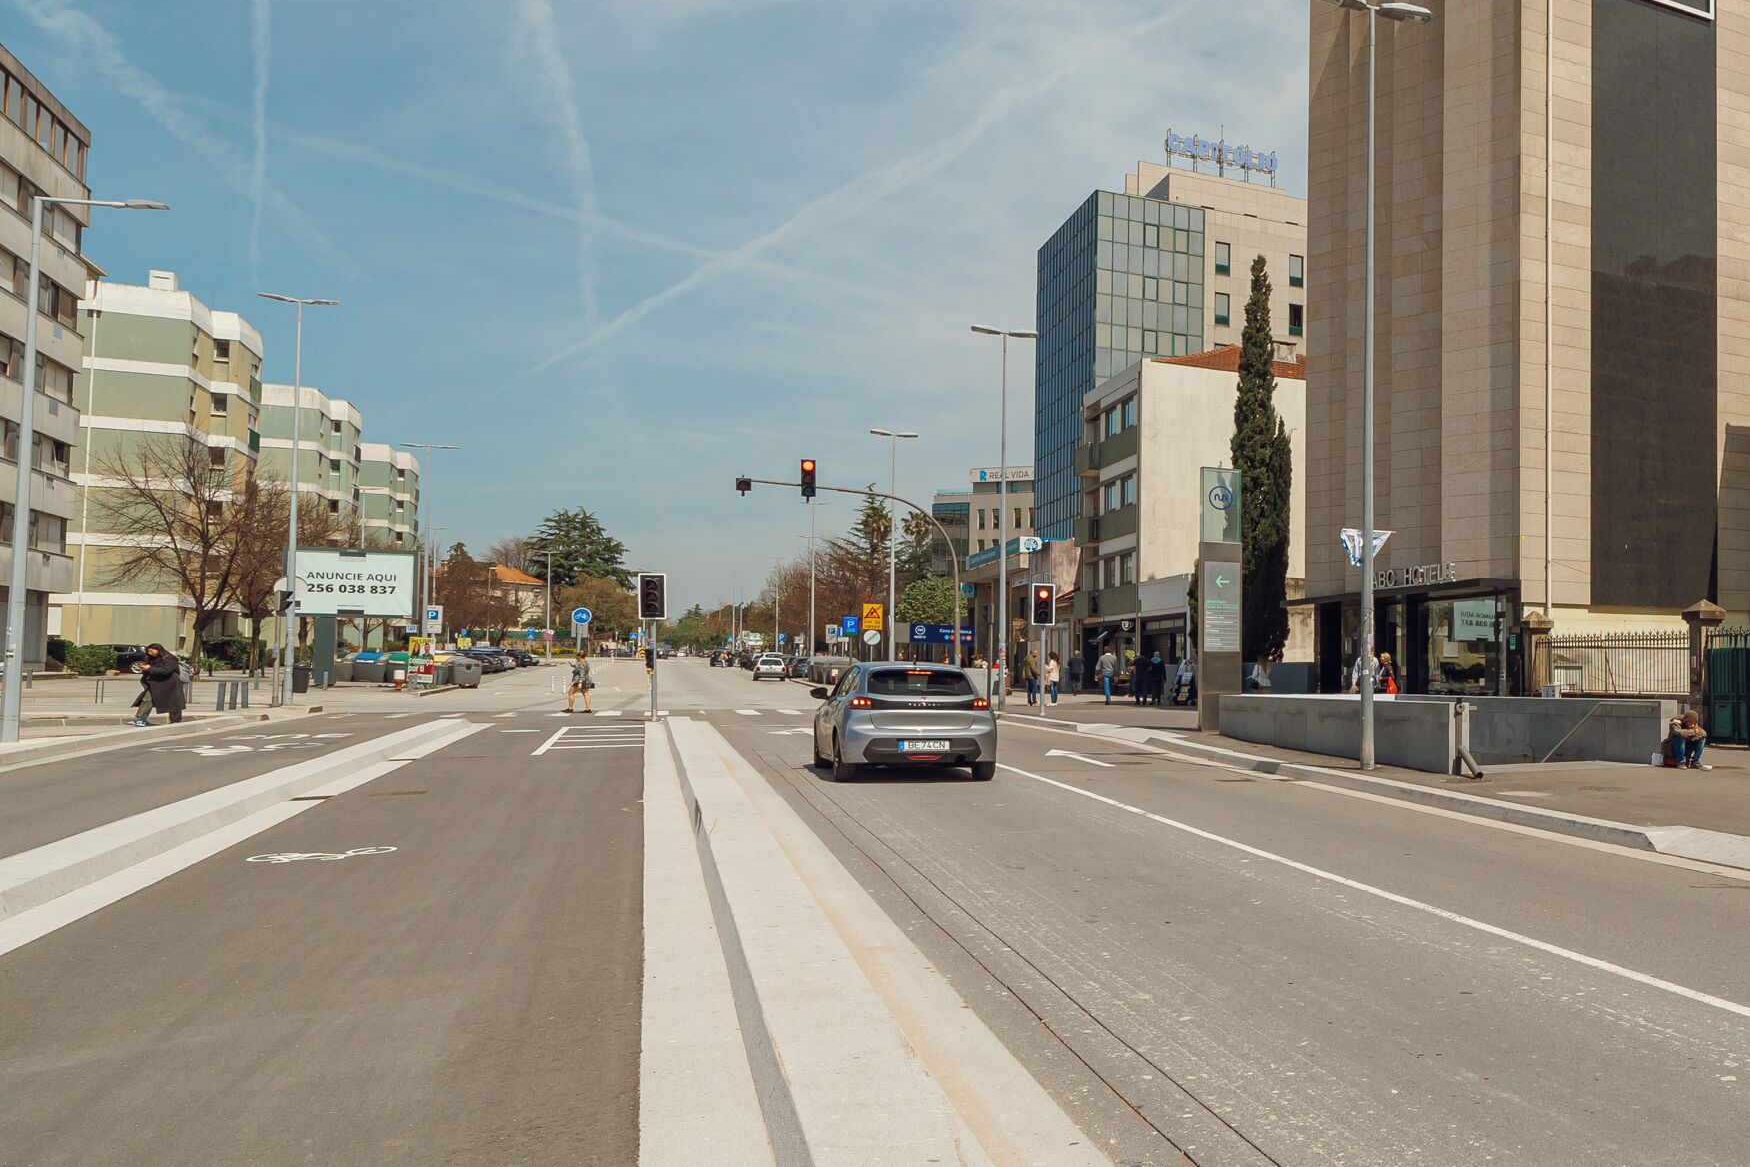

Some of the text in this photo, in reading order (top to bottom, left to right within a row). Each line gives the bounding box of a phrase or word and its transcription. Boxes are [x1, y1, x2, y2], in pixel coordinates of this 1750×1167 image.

[1166, 133, 1278, 171] CAPITÓLIO
[1010, 471, 1030, 479] VIDA
[306, 572, 397, 582] ANUNCIE AQUI
[1403, 561, 1455, 585] HOTELS
[307, 583, 396, 595] 256 038 837
[428, 611, 437, 619] P
